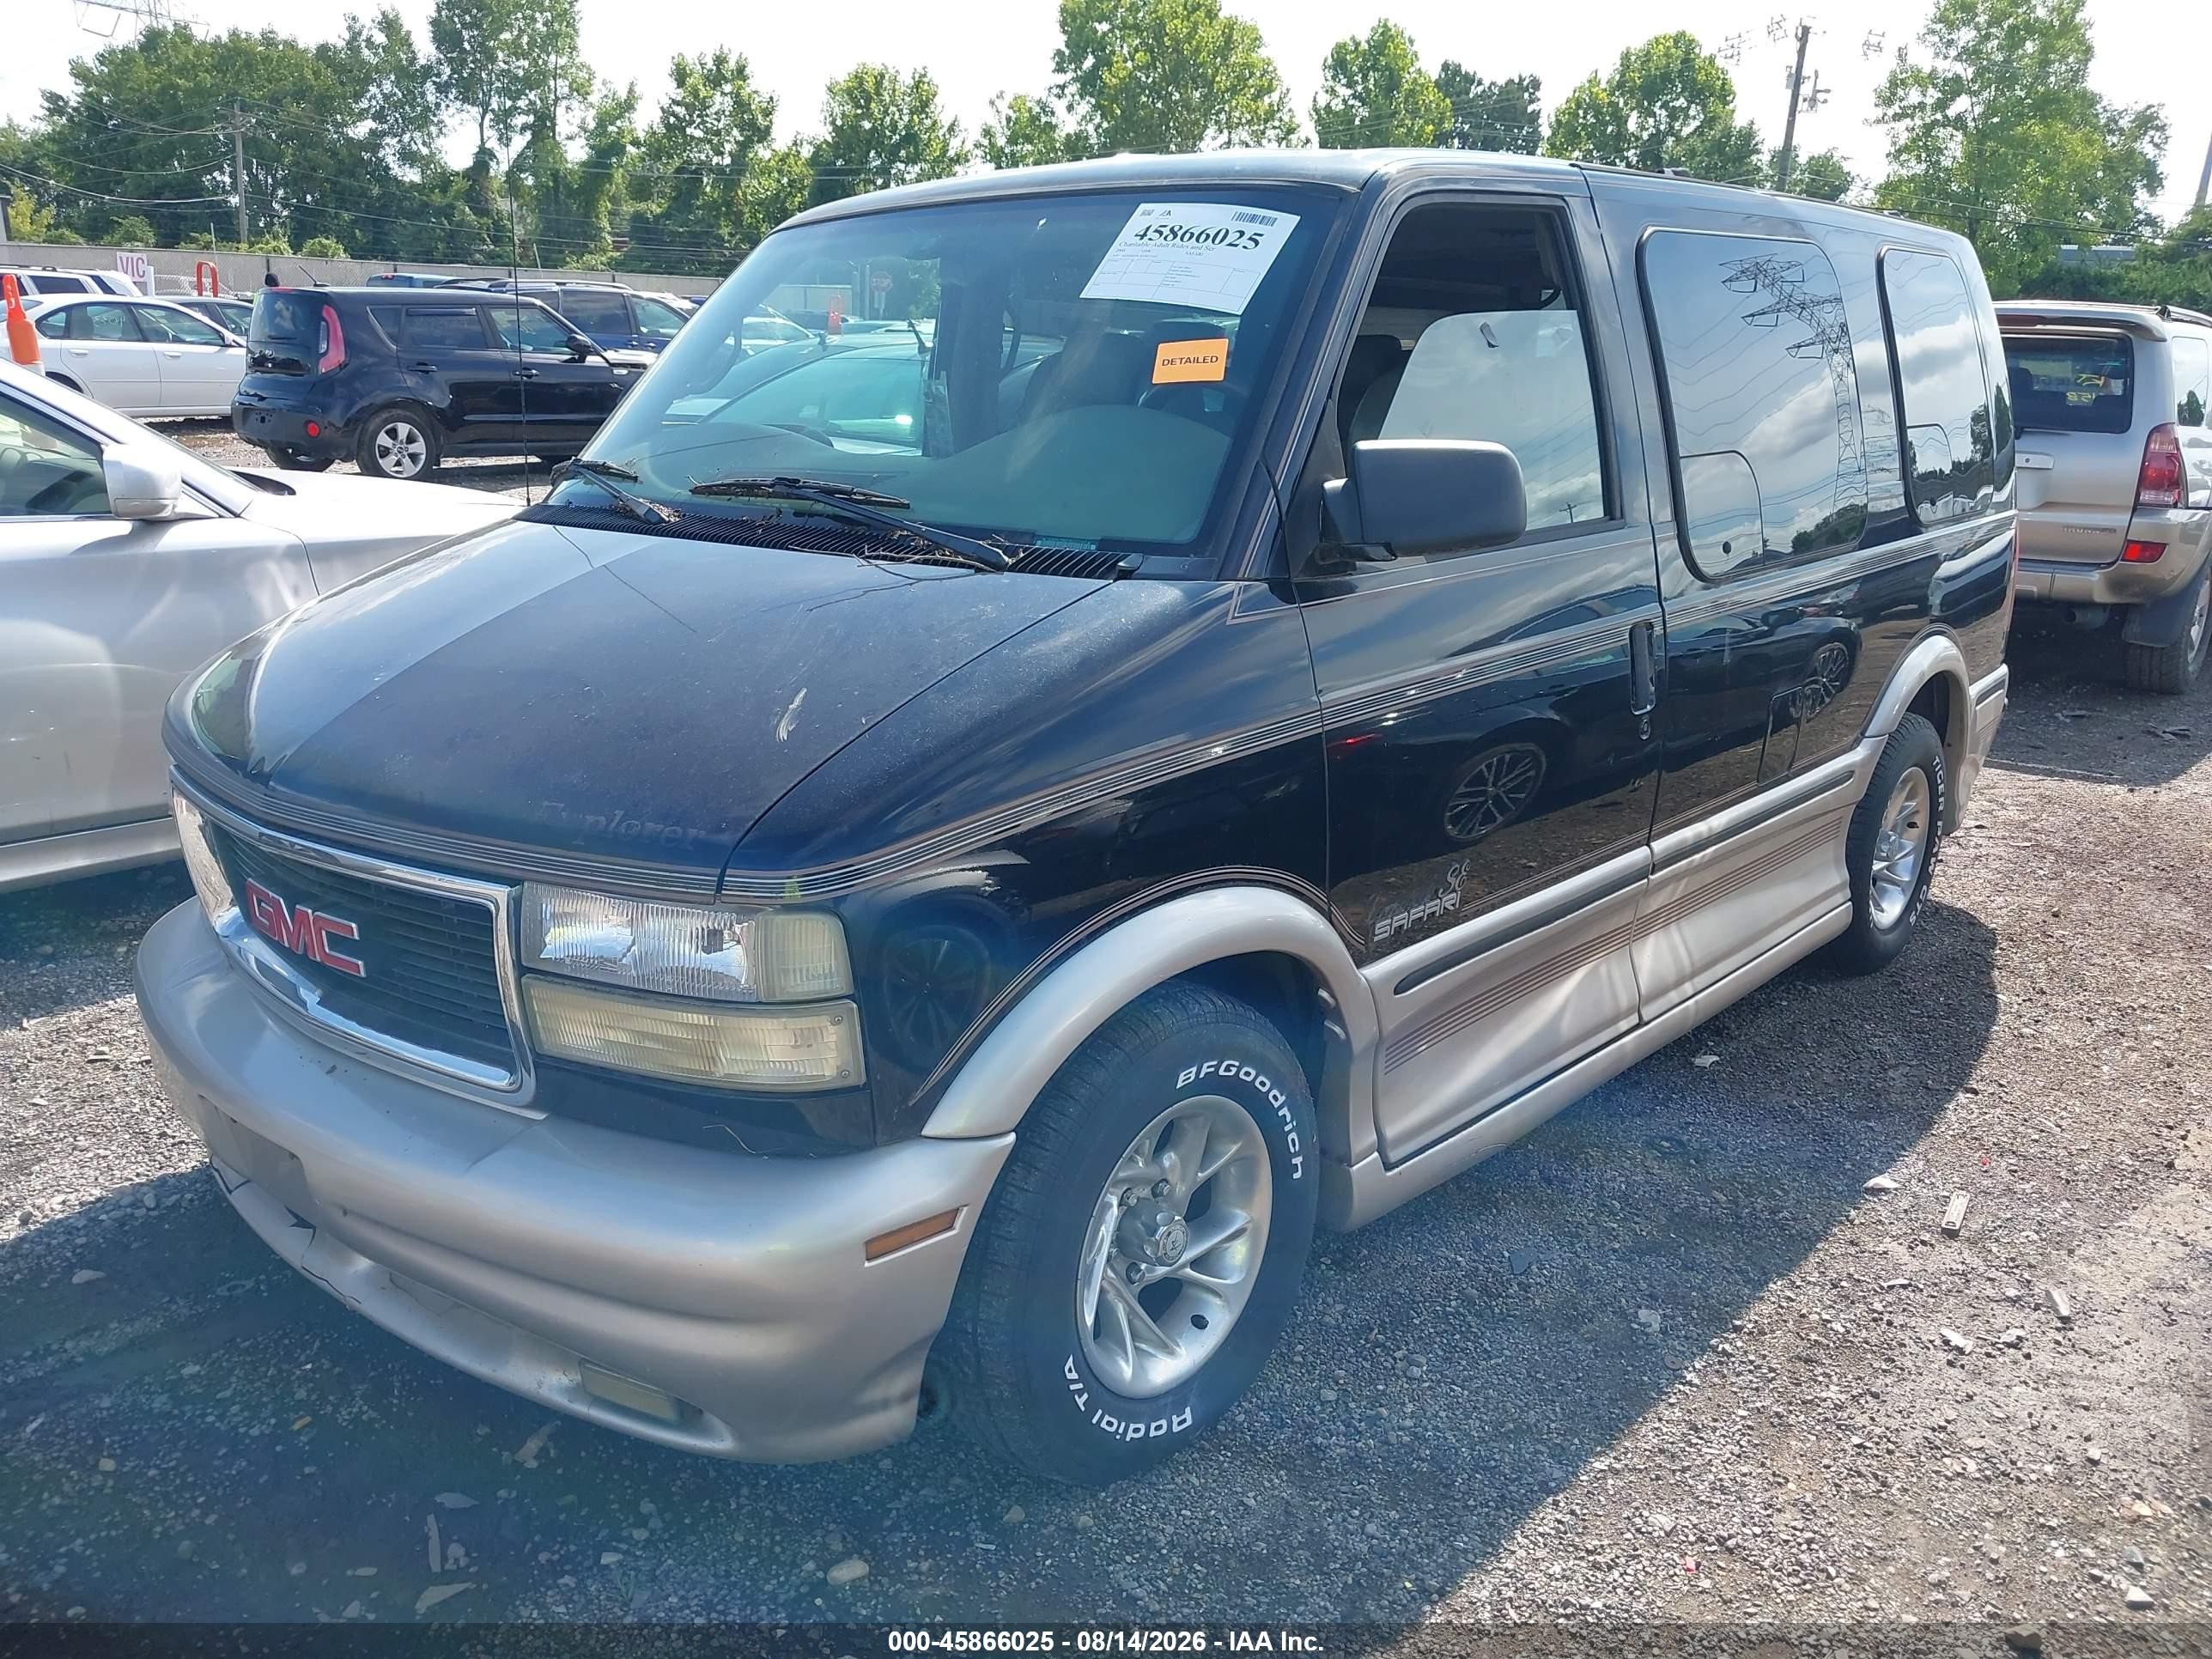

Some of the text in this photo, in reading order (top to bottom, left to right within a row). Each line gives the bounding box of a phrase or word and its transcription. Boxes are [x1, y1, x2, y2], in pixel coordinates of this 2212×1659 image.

[1133, 223, 1265, 251] 45866025
[118, 256, 146, 278] VIC
[1162, 356, 1219, 367] DETAILED
[1932, 755, 1945, 812] TIGER
[1928, 820, 1943, 876] PAW
[246, 878, 367, 978] GMC
[1374, 890, 1462, 942] SAFARI
[1176, 1060, 1304, 1180] BFGoodrich
[1064, 1354, 1194, 1443] Radial T/A
